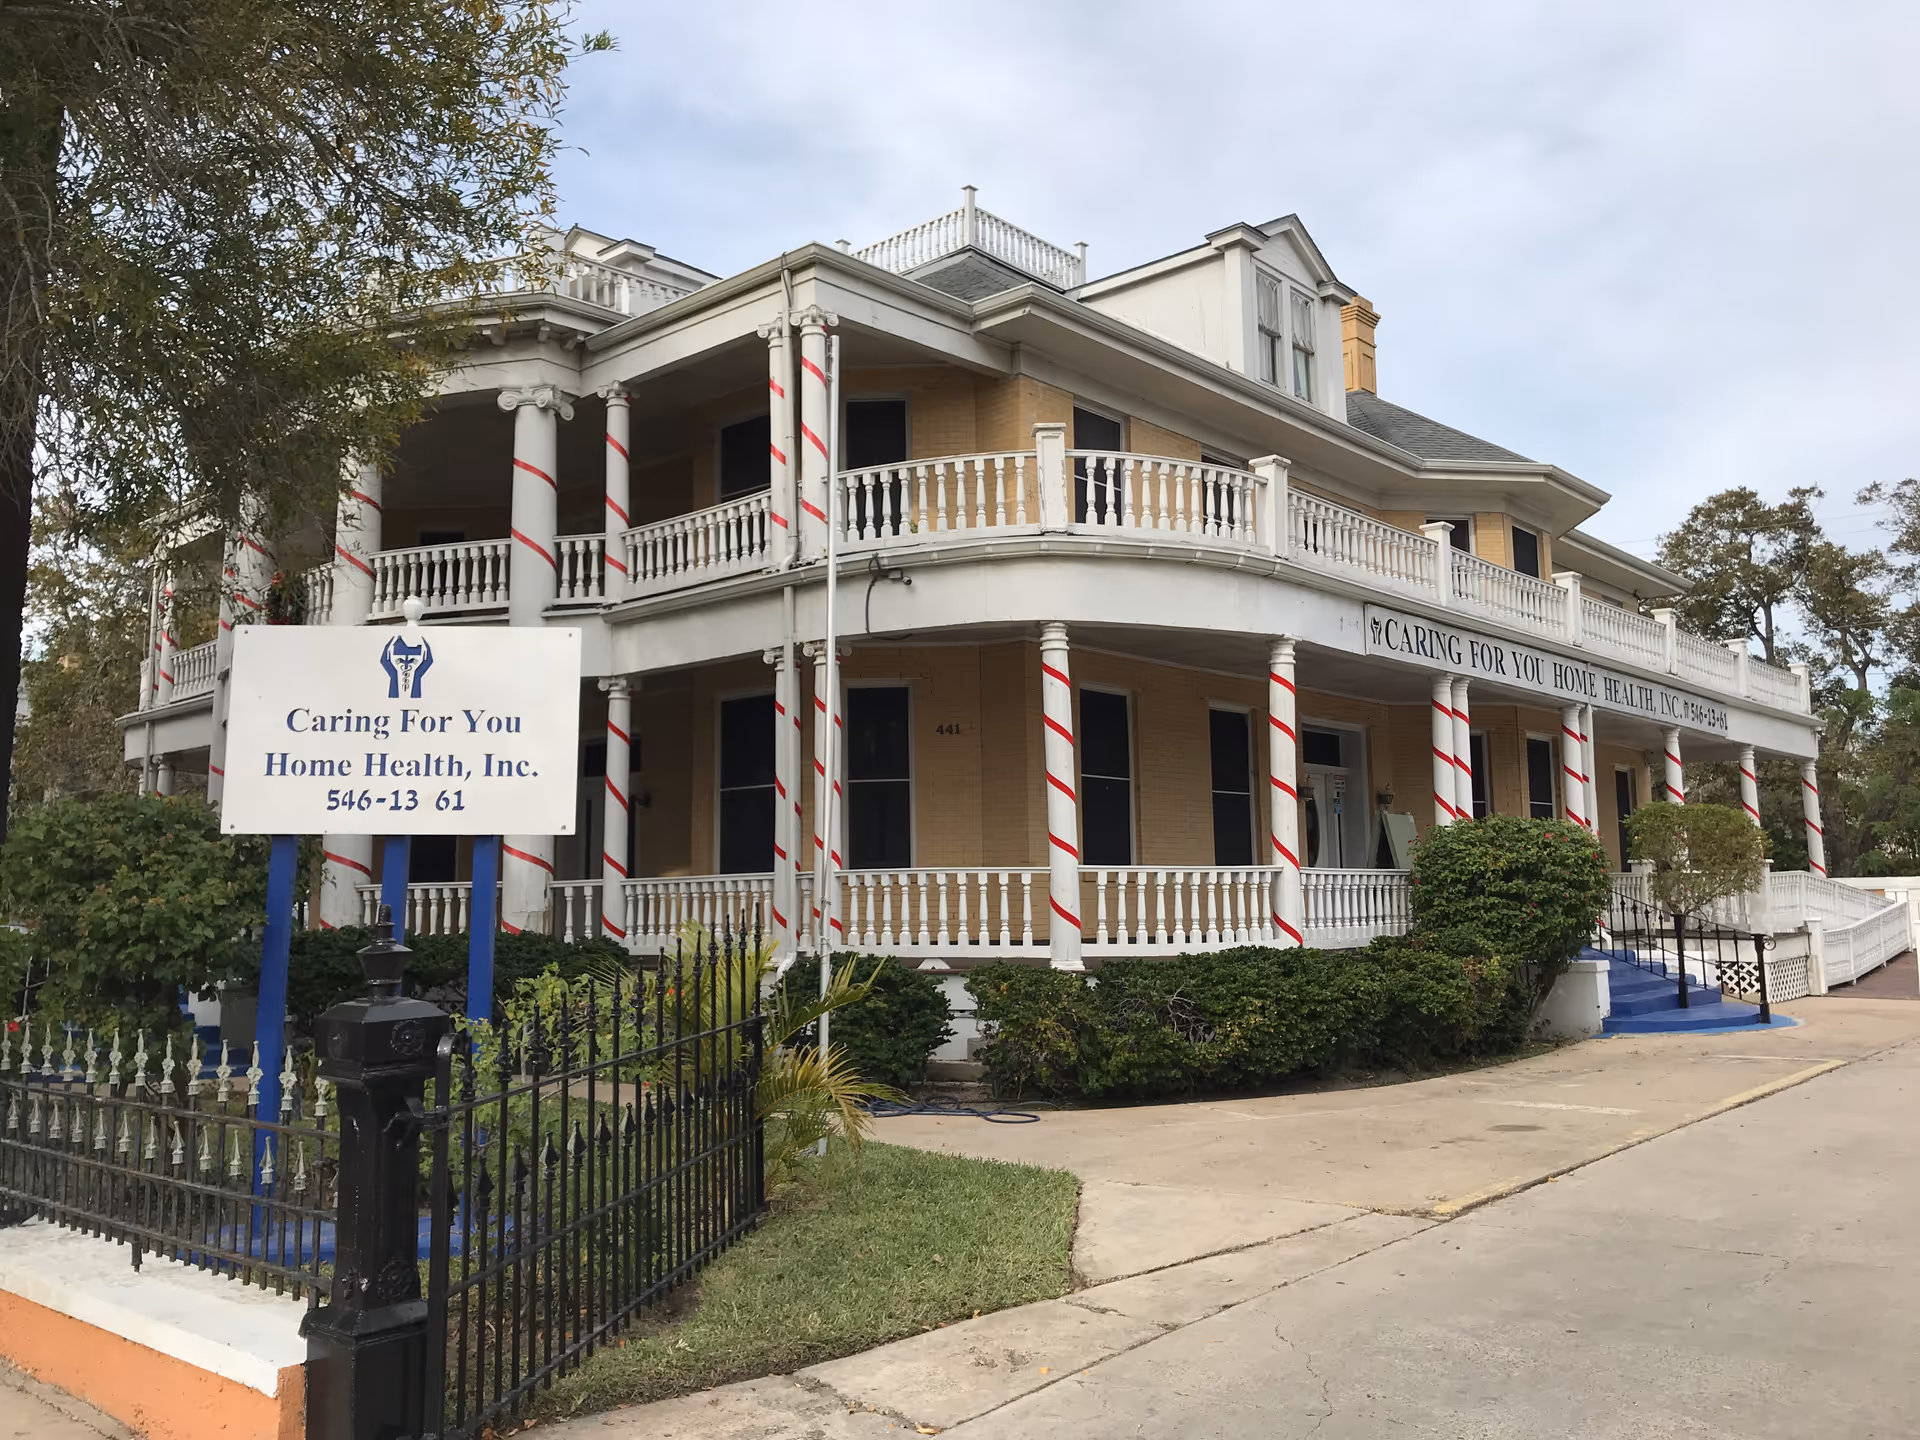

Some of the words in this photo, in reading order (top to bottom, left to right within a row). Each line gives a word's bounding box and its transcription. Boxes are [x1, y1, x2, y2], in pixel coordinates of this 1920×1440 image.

[1385, 618, 1462, 665] CARING
[1469, 639, 1506, 675] FOR
[1511, 651, 1545, 685] YOU
[1553, 662, 1597, 698] HOME
[1603, 676, 1657, 716] HEALTH,
[1660, 692, 1683, 719] INC.
[1691, 705, 1728, 731] 546-13-61
[286, 707, 390, 740] Caring
[400, 709, 452, 733] For
[461, 709, 521, 733] You
[936, 723, 960, 735] 441
[264, 752, 352, 777] Home
[364, 752, 472, 781] Health,
[483, 753, 539, 778] Inc.
[326, 789, 419, 811] 546-13
[435, 789, 466, 811] 61
